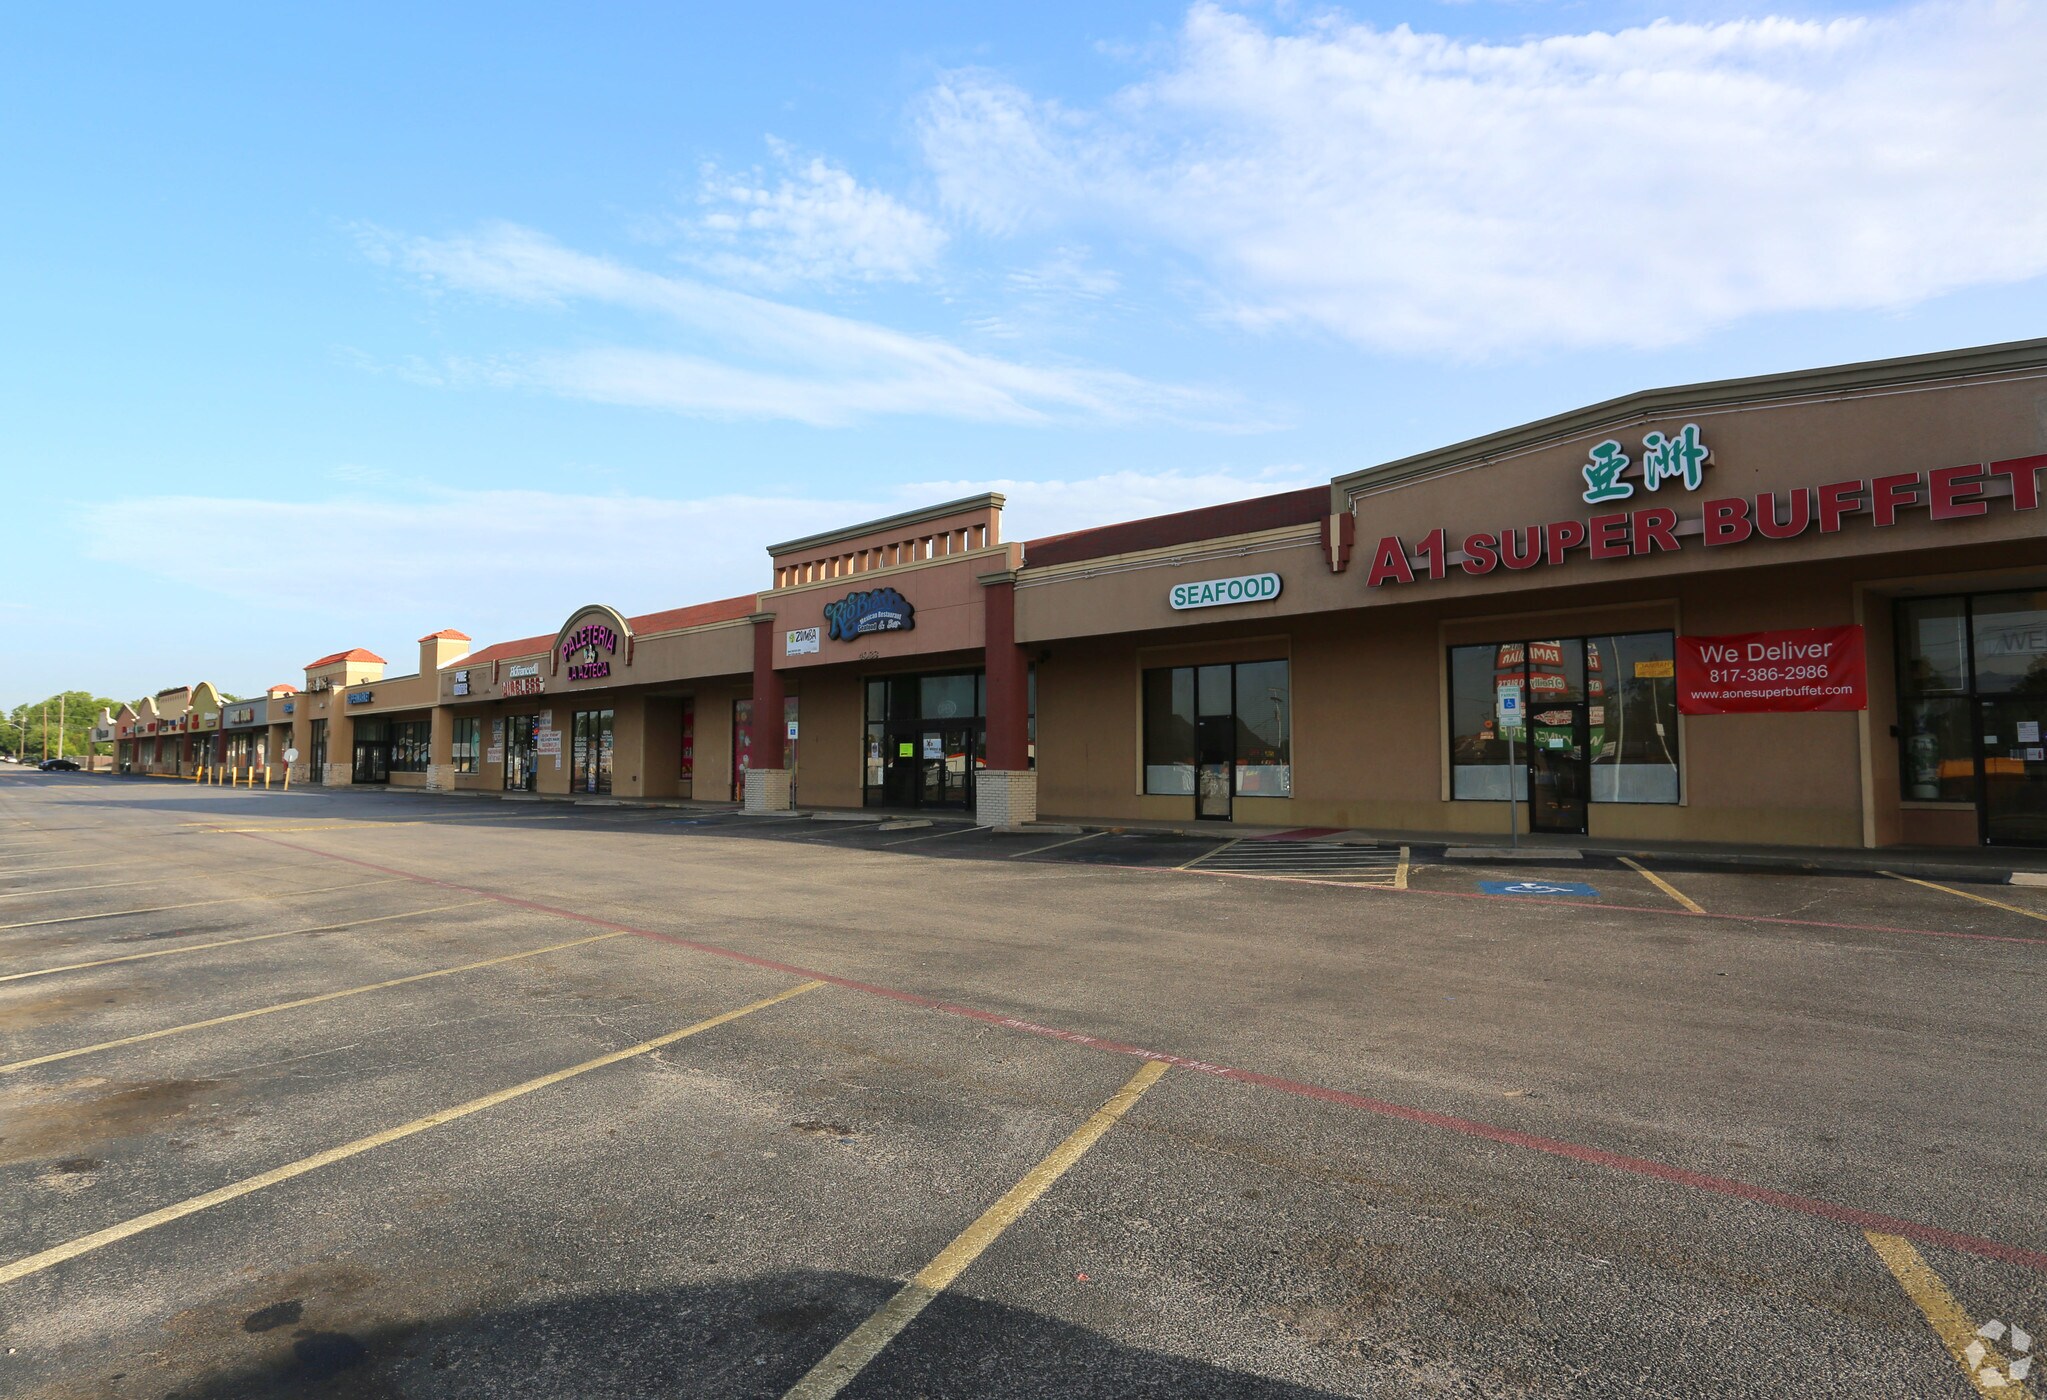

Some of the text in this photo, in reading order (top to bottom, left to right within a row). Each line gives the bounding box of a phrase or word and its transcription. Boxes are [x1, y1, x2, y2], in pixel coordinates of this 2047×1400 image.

[1366, 454, 2047, 587] A1 SUPER BUFFET
[1174, 576, 1275, 606] SEAFOOD
[562, 625, 616, 662] PALETERIA
[1700, 641, 1832, 663] We Deliver
[578, 662, 608, 679] AZTECA
[1710, 665, 1828, 683] 817-386-2986
[1691, 685, 1852, 700] www.aonesuperbuffet.com
